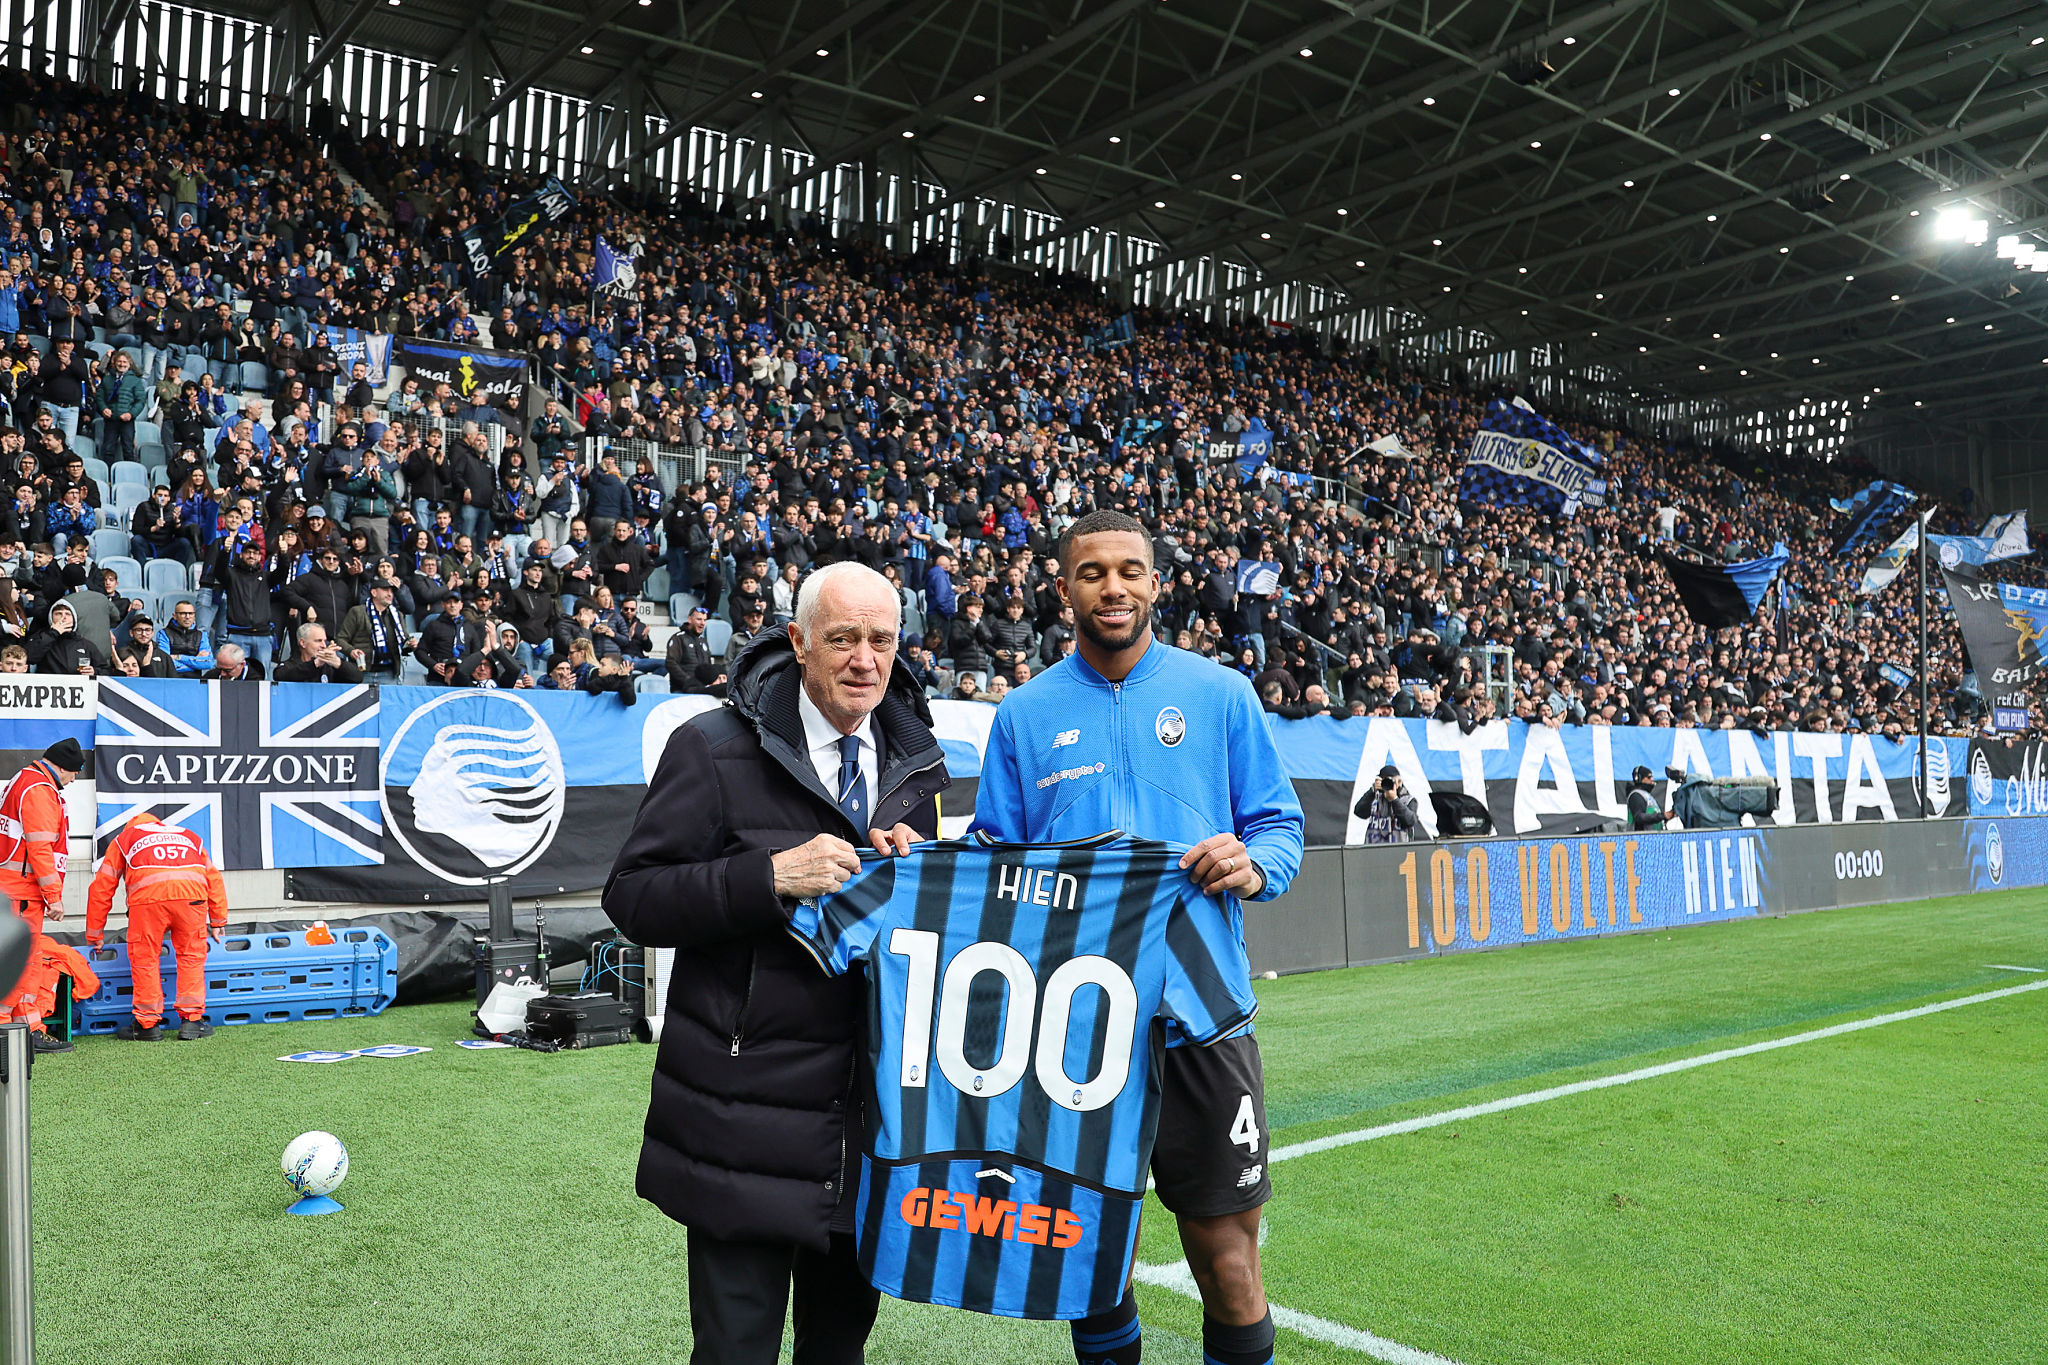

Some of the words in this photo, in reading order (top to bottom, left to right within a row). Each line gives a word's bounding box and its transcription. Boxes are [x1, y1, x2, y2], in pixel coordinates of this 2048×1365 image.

[415, 366, 452, 384] mai
[0, 684, 85, 709] EMPRE
[116, 753, 358, 785] CAPIZZONE
[152, 845, 189, 860] 057
[1834, 849, 1884, 881] 00:00
[997, 863, 1079, 911] HIEN
[1399, 846, 1491, 949] 100
[1517, 839, 1643, 936] VOLTE
[1681, 836, 1759, 915] HIEN
[889, 927, 1139, 1113] 100
[1229, 1094, 1261, 1154] 4
